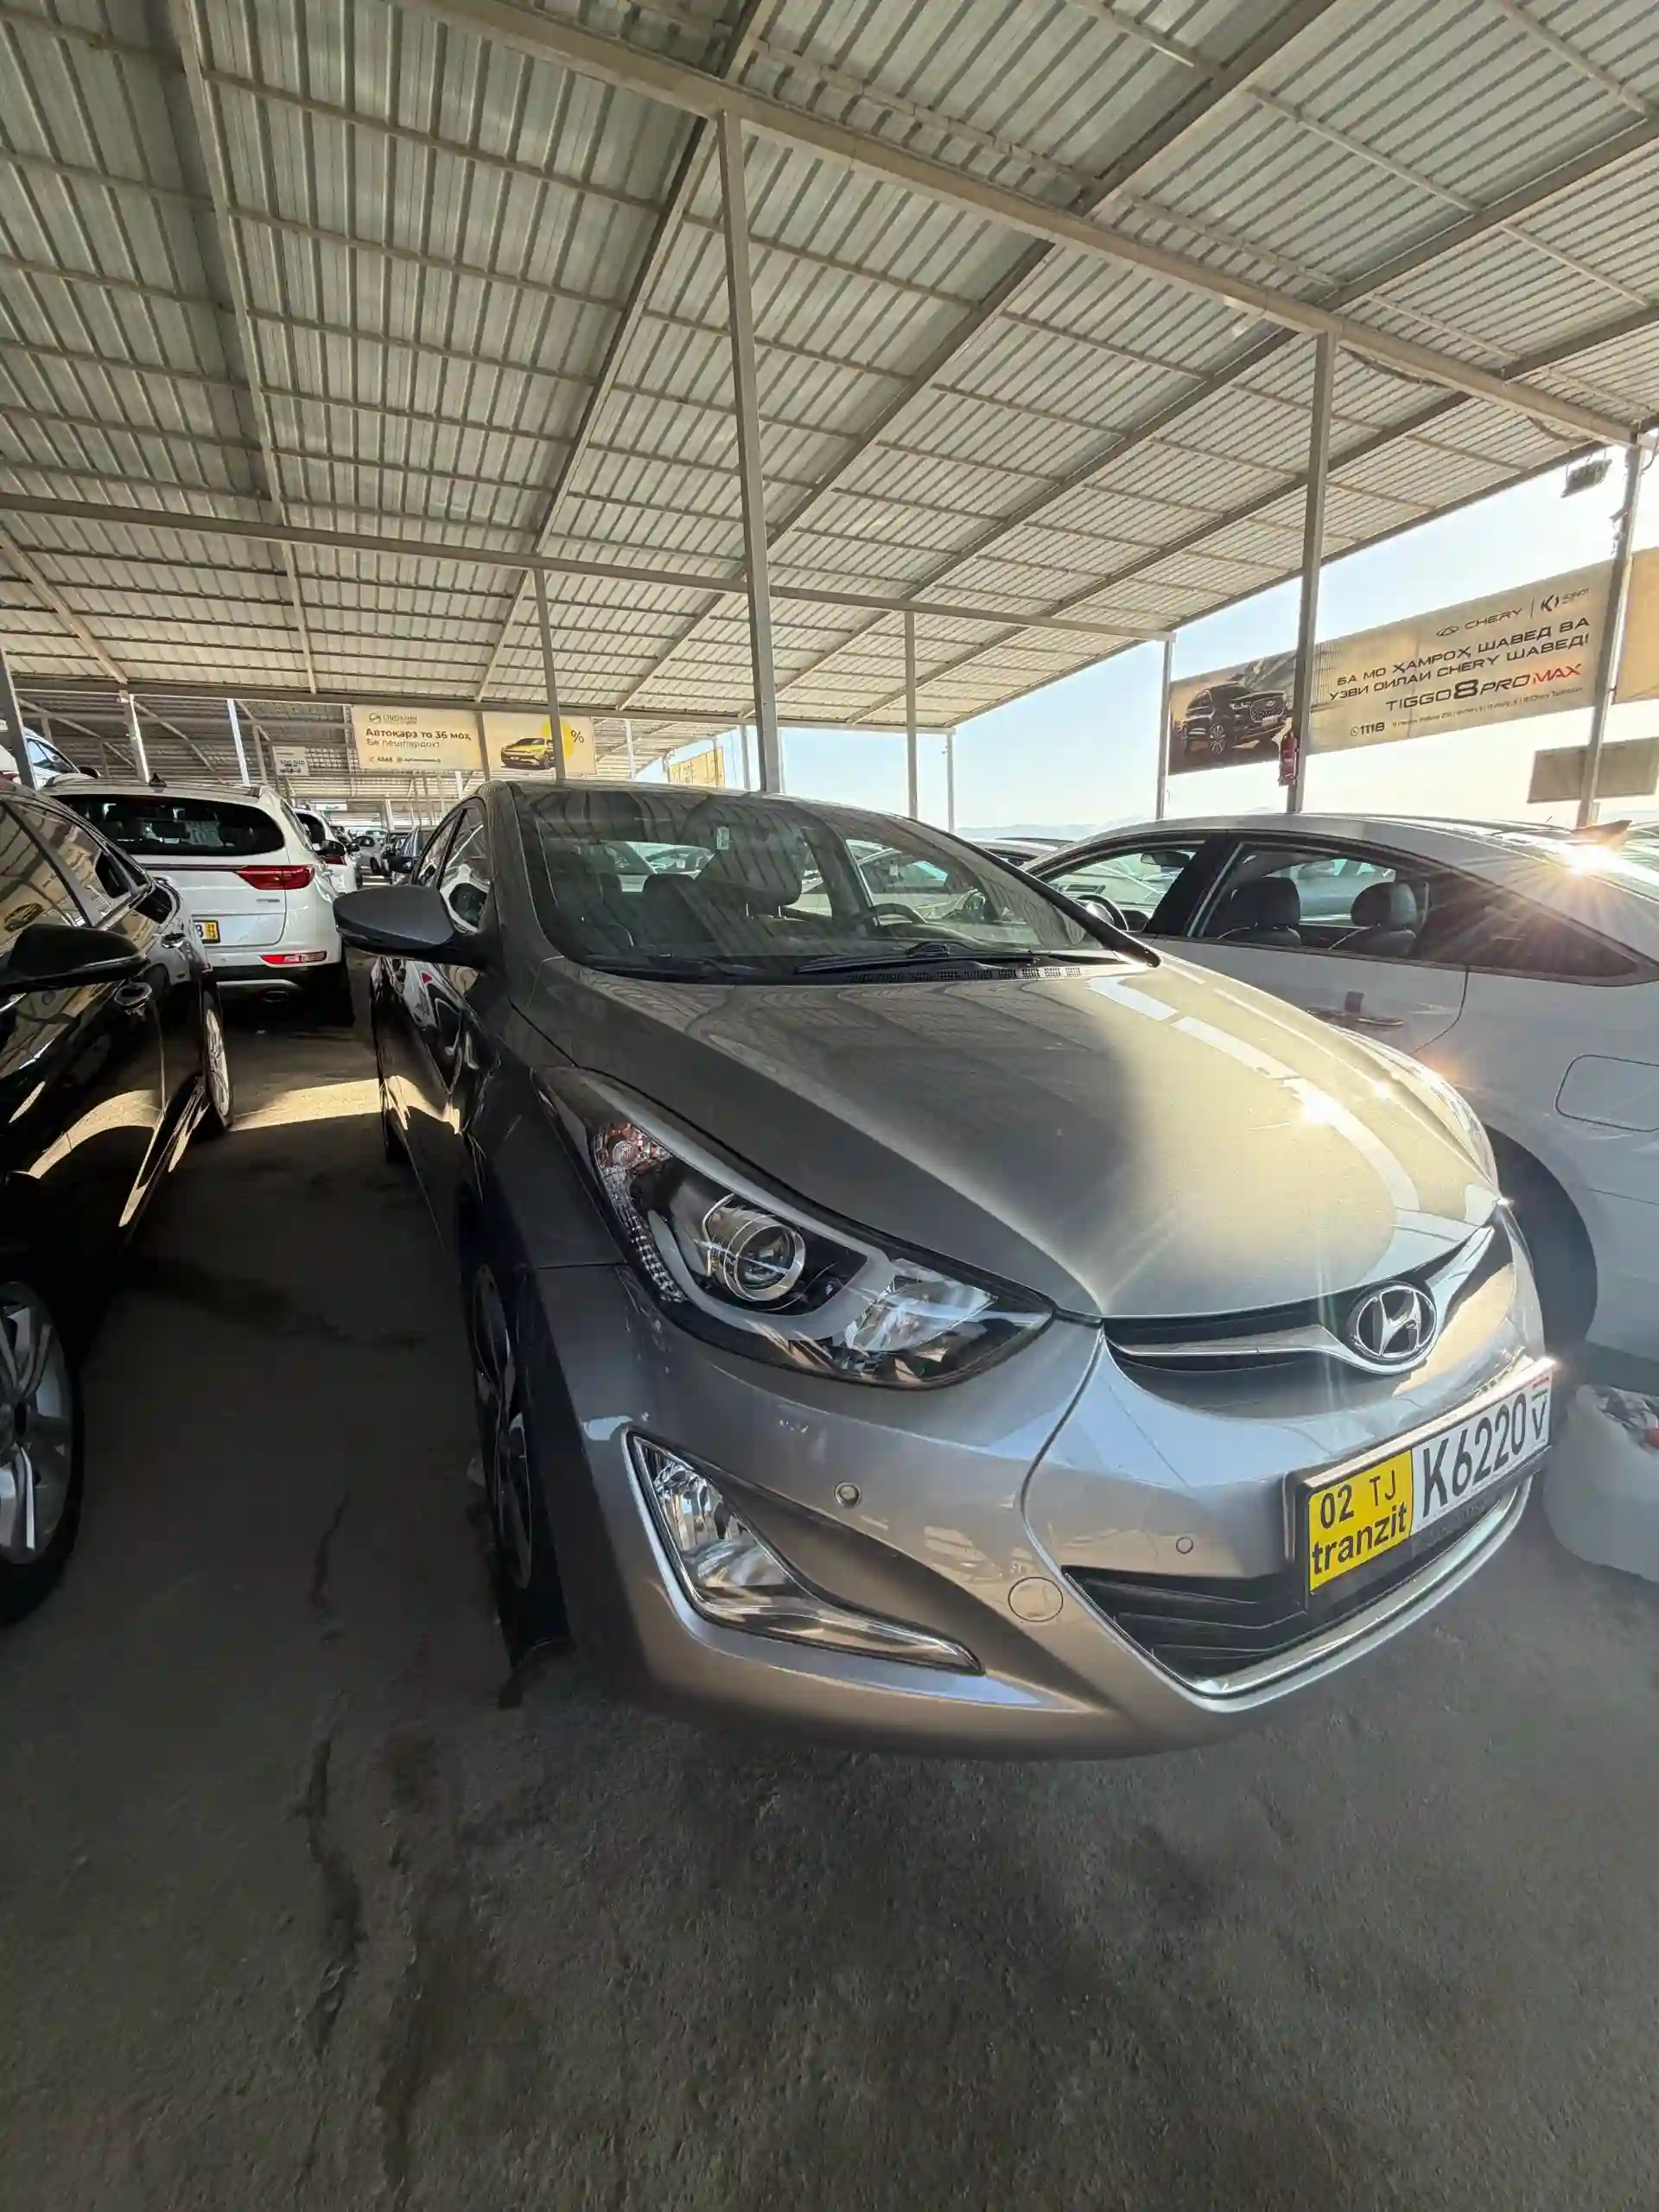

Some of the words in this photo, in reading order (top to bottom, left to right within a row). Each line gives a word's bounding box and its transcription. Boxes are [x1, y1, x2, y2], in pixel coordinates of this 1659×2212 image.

[1465, 607, 1523, 630] CHERY
[1337, 674, 1358, 686] БА
[1363, 667, 1387, 680] МО
[1478, 626, 1552, 654] ШАВЕД
[1559, 617, 1590, 633] ВА
[1437, 654, 1501, 677] CHERY
[1506, 633, 1590, 662] ШАВЕД!
[435, 730, 448, 740] 36
[1360, 721, 1385, 735] 1118
[1422, 1392, 1527, 1518] K6220
[1320, 1484, 1355, 1529] 02
[1369, 1470, 1396, 1506] TJ
[1312, 1501, 1408, 1575] tranzit
